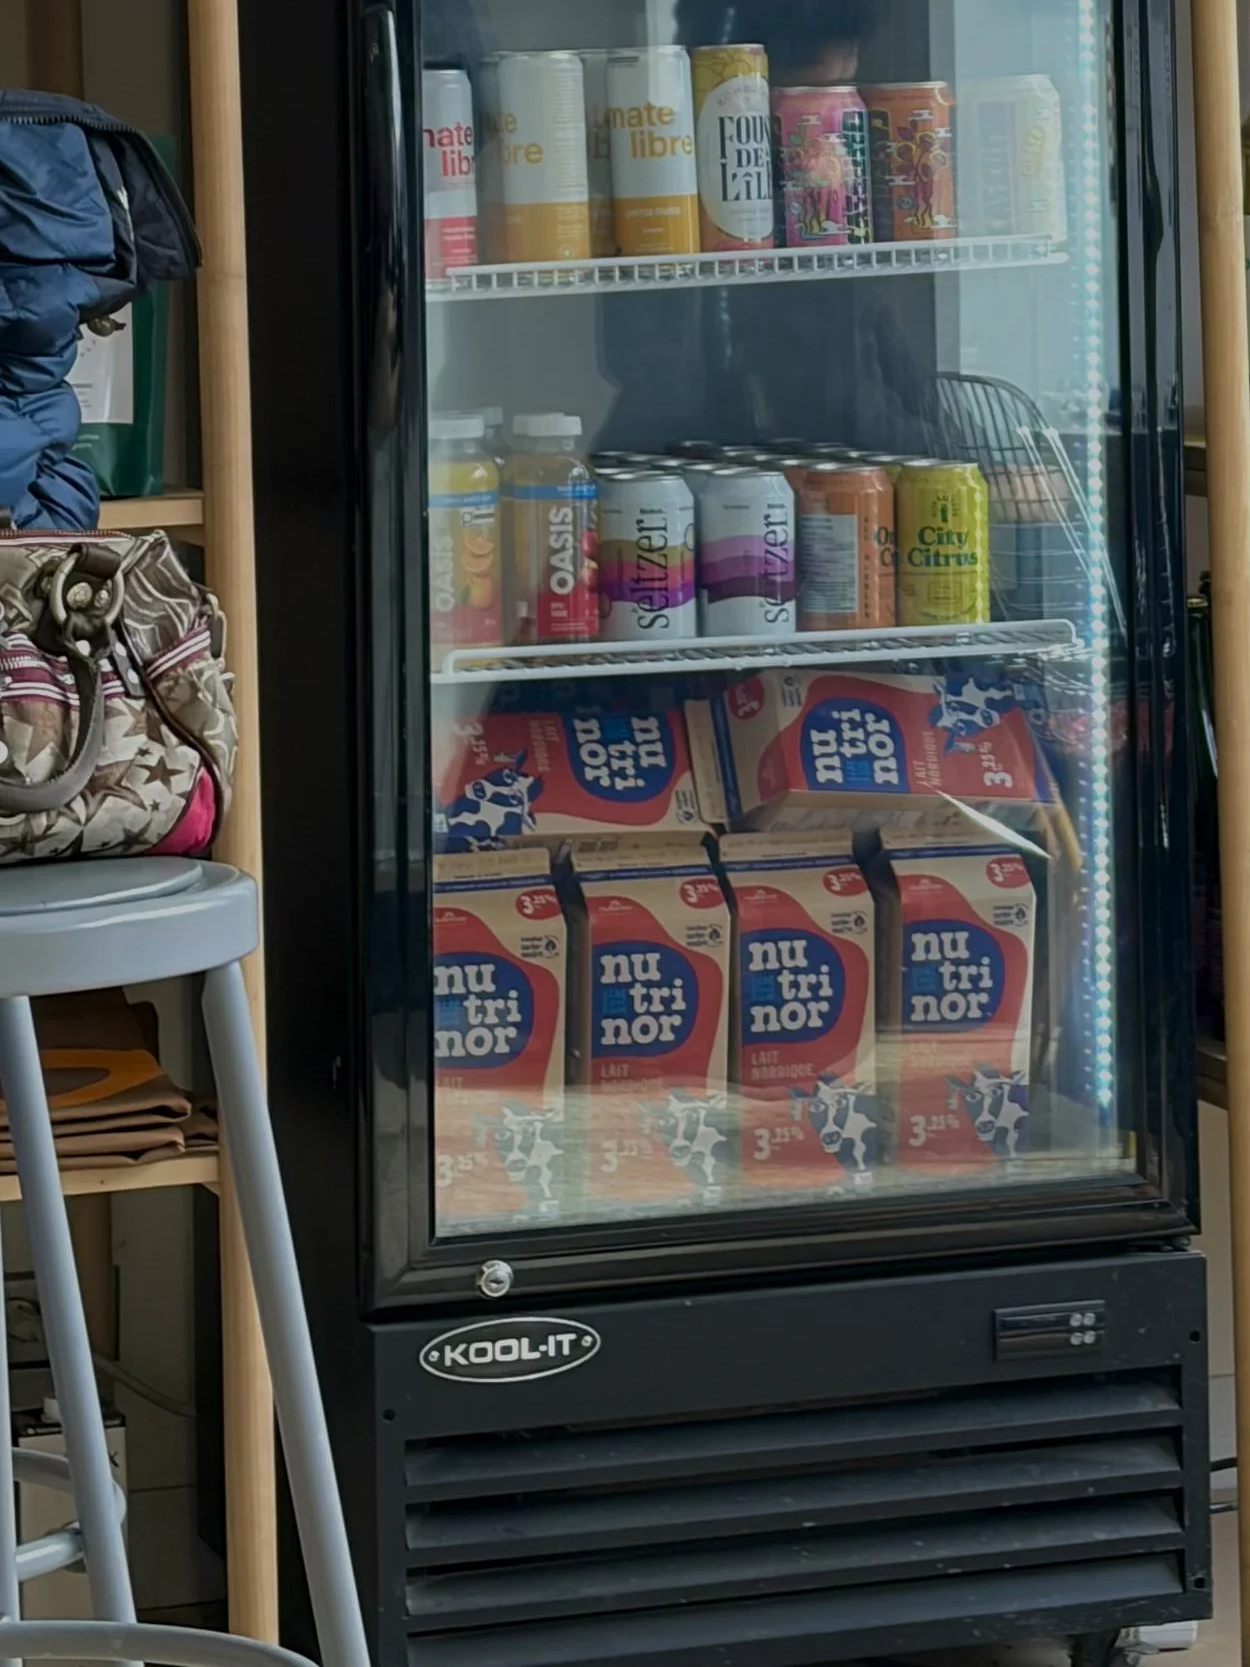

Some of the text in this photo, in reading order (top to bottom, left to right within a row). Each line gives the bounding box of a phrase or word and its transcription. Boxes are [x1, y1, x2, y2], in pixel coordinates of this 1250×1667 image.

[629, 130, 693, 159] libre
[549, 505, 574, 595] OASIS
[918, 525, 970, 549] City
[434, 535, 456, 612] OASIS
[907, 547, 978, 568] Citrus
[630, 716, 667, 768] nu
[832, 708, 867, 758] tri
[867, 712, 899, 786] nor
[572, 717, 612, 789] nor
[608, 740, 645, 791] tri
[809, 728, 844, 784] nu
[748, 939, 808, 972] nu
[911, 931, 971, 961] nu
[433, 963, 496, 995] nu
[600, 952, 661, 984] nu
[777, 965, 834, 1001] tri
[939, 956, 994, 991] tri
[463, 990, 522, 1025] tri
[630, 978, 687, 1014] tri
[910, 991, 990, 1023] nor
[600, 1014, 682, 1046] nor
[750, 1001, 830, 1033] nor
[434, 1025, 518, 1058] nor
[752, 1050, 779, 1065] LAIT
[601, 1063, 629, 1078] LAIT
[751, 1063, 815, 1081] NORDIQUE
[444, 1333, 577, 1366] KOOL-IT
